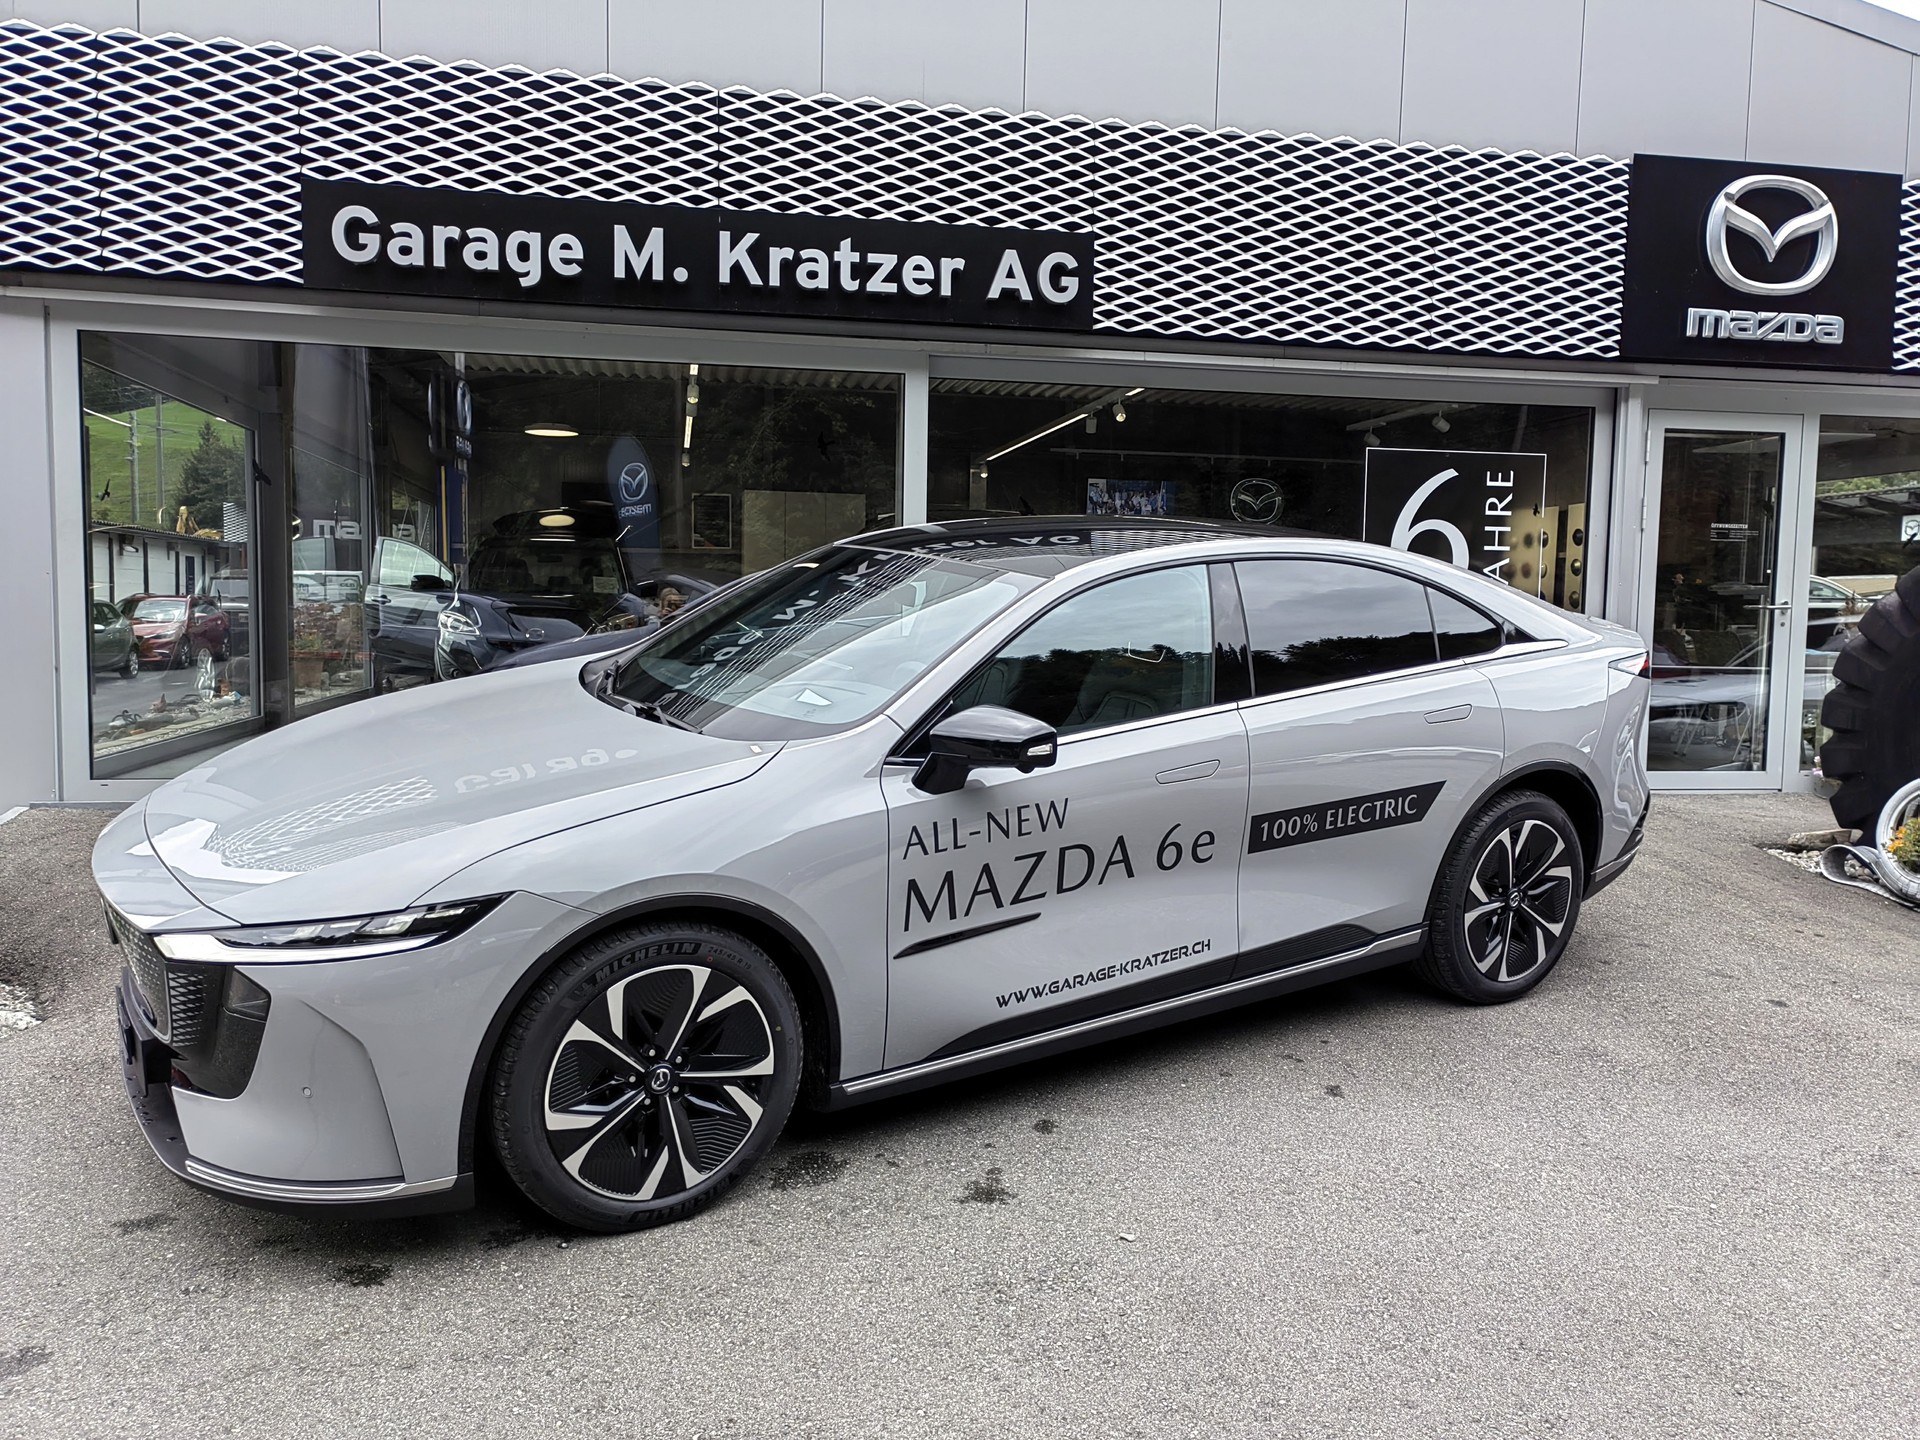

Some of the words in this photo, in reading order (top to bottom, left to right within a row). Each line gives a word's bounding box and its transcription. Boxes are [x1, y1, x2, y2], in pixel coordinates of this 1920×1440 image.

[331, 204, 584, 288] Garage
[613, 224, 689, 282] M.
[718, 230, 966, 298] Kratzer
[986, 248, 1080, 304] AG
[1390, 468, 1470, 571] 6
[1483, 470, 1514, 585] AHRE
[902, 797, 1069, 860] ALL-NEW
[1260, 812, 1319, 842] 100%
[1325, 794, 1418, 830] ELECTRIC
[903, 834, 1135, 932] MAZDA
[1156, 822, 1216, 872] 6e
[594, 942, 696, 985] MICHELIN
[995, 938, 1212, 1009] WWW.GARAGE-KRATZER.CH
